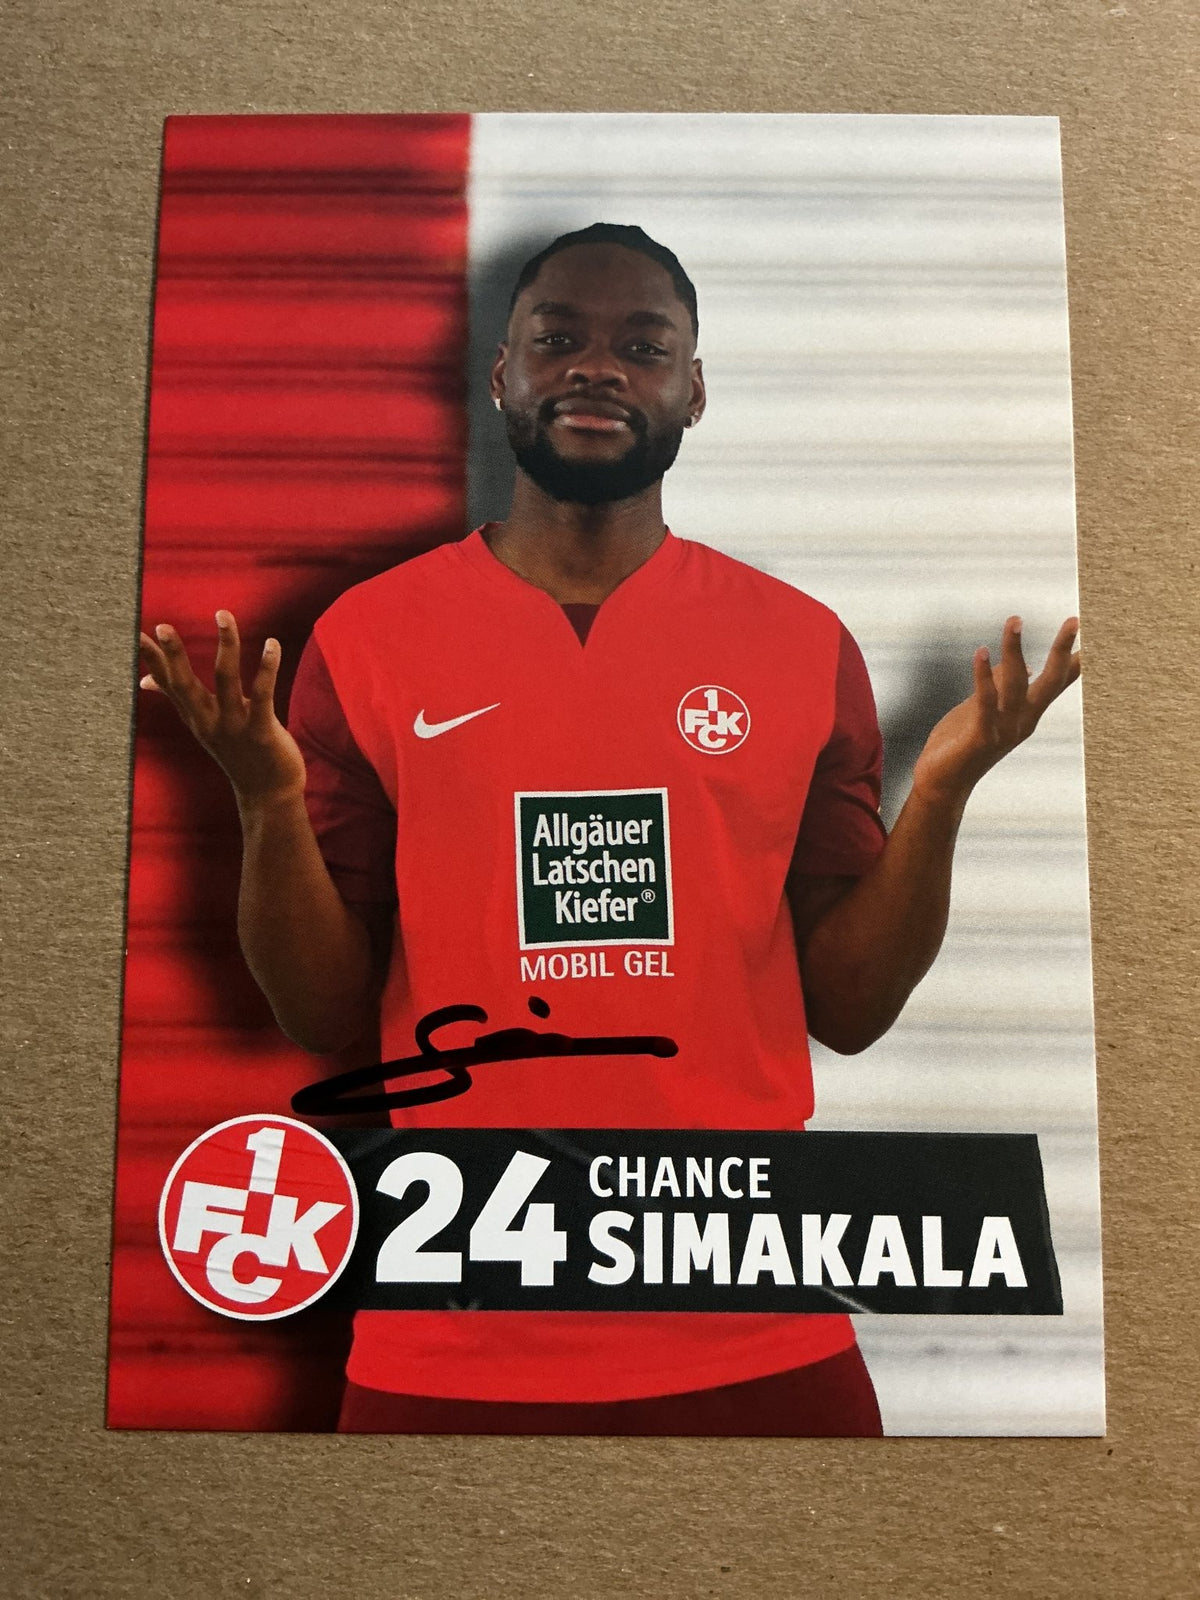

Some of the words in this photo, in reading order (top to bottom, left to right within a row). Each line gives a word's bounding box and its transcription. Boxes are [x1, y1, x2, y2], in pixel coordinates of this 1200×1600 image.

[533, 812, 653, 855] Allgäuer
[532, 850, 656, 886] Latschen
[520, 951, 615, 982] MOBIL
[623, 950, 675, 978] GEL
[588, 1155, 772, 1199] CHANCE
[375, 1150, 568, 1287] 24
[587, 1210, 1029, 1288] SIMAKALA
